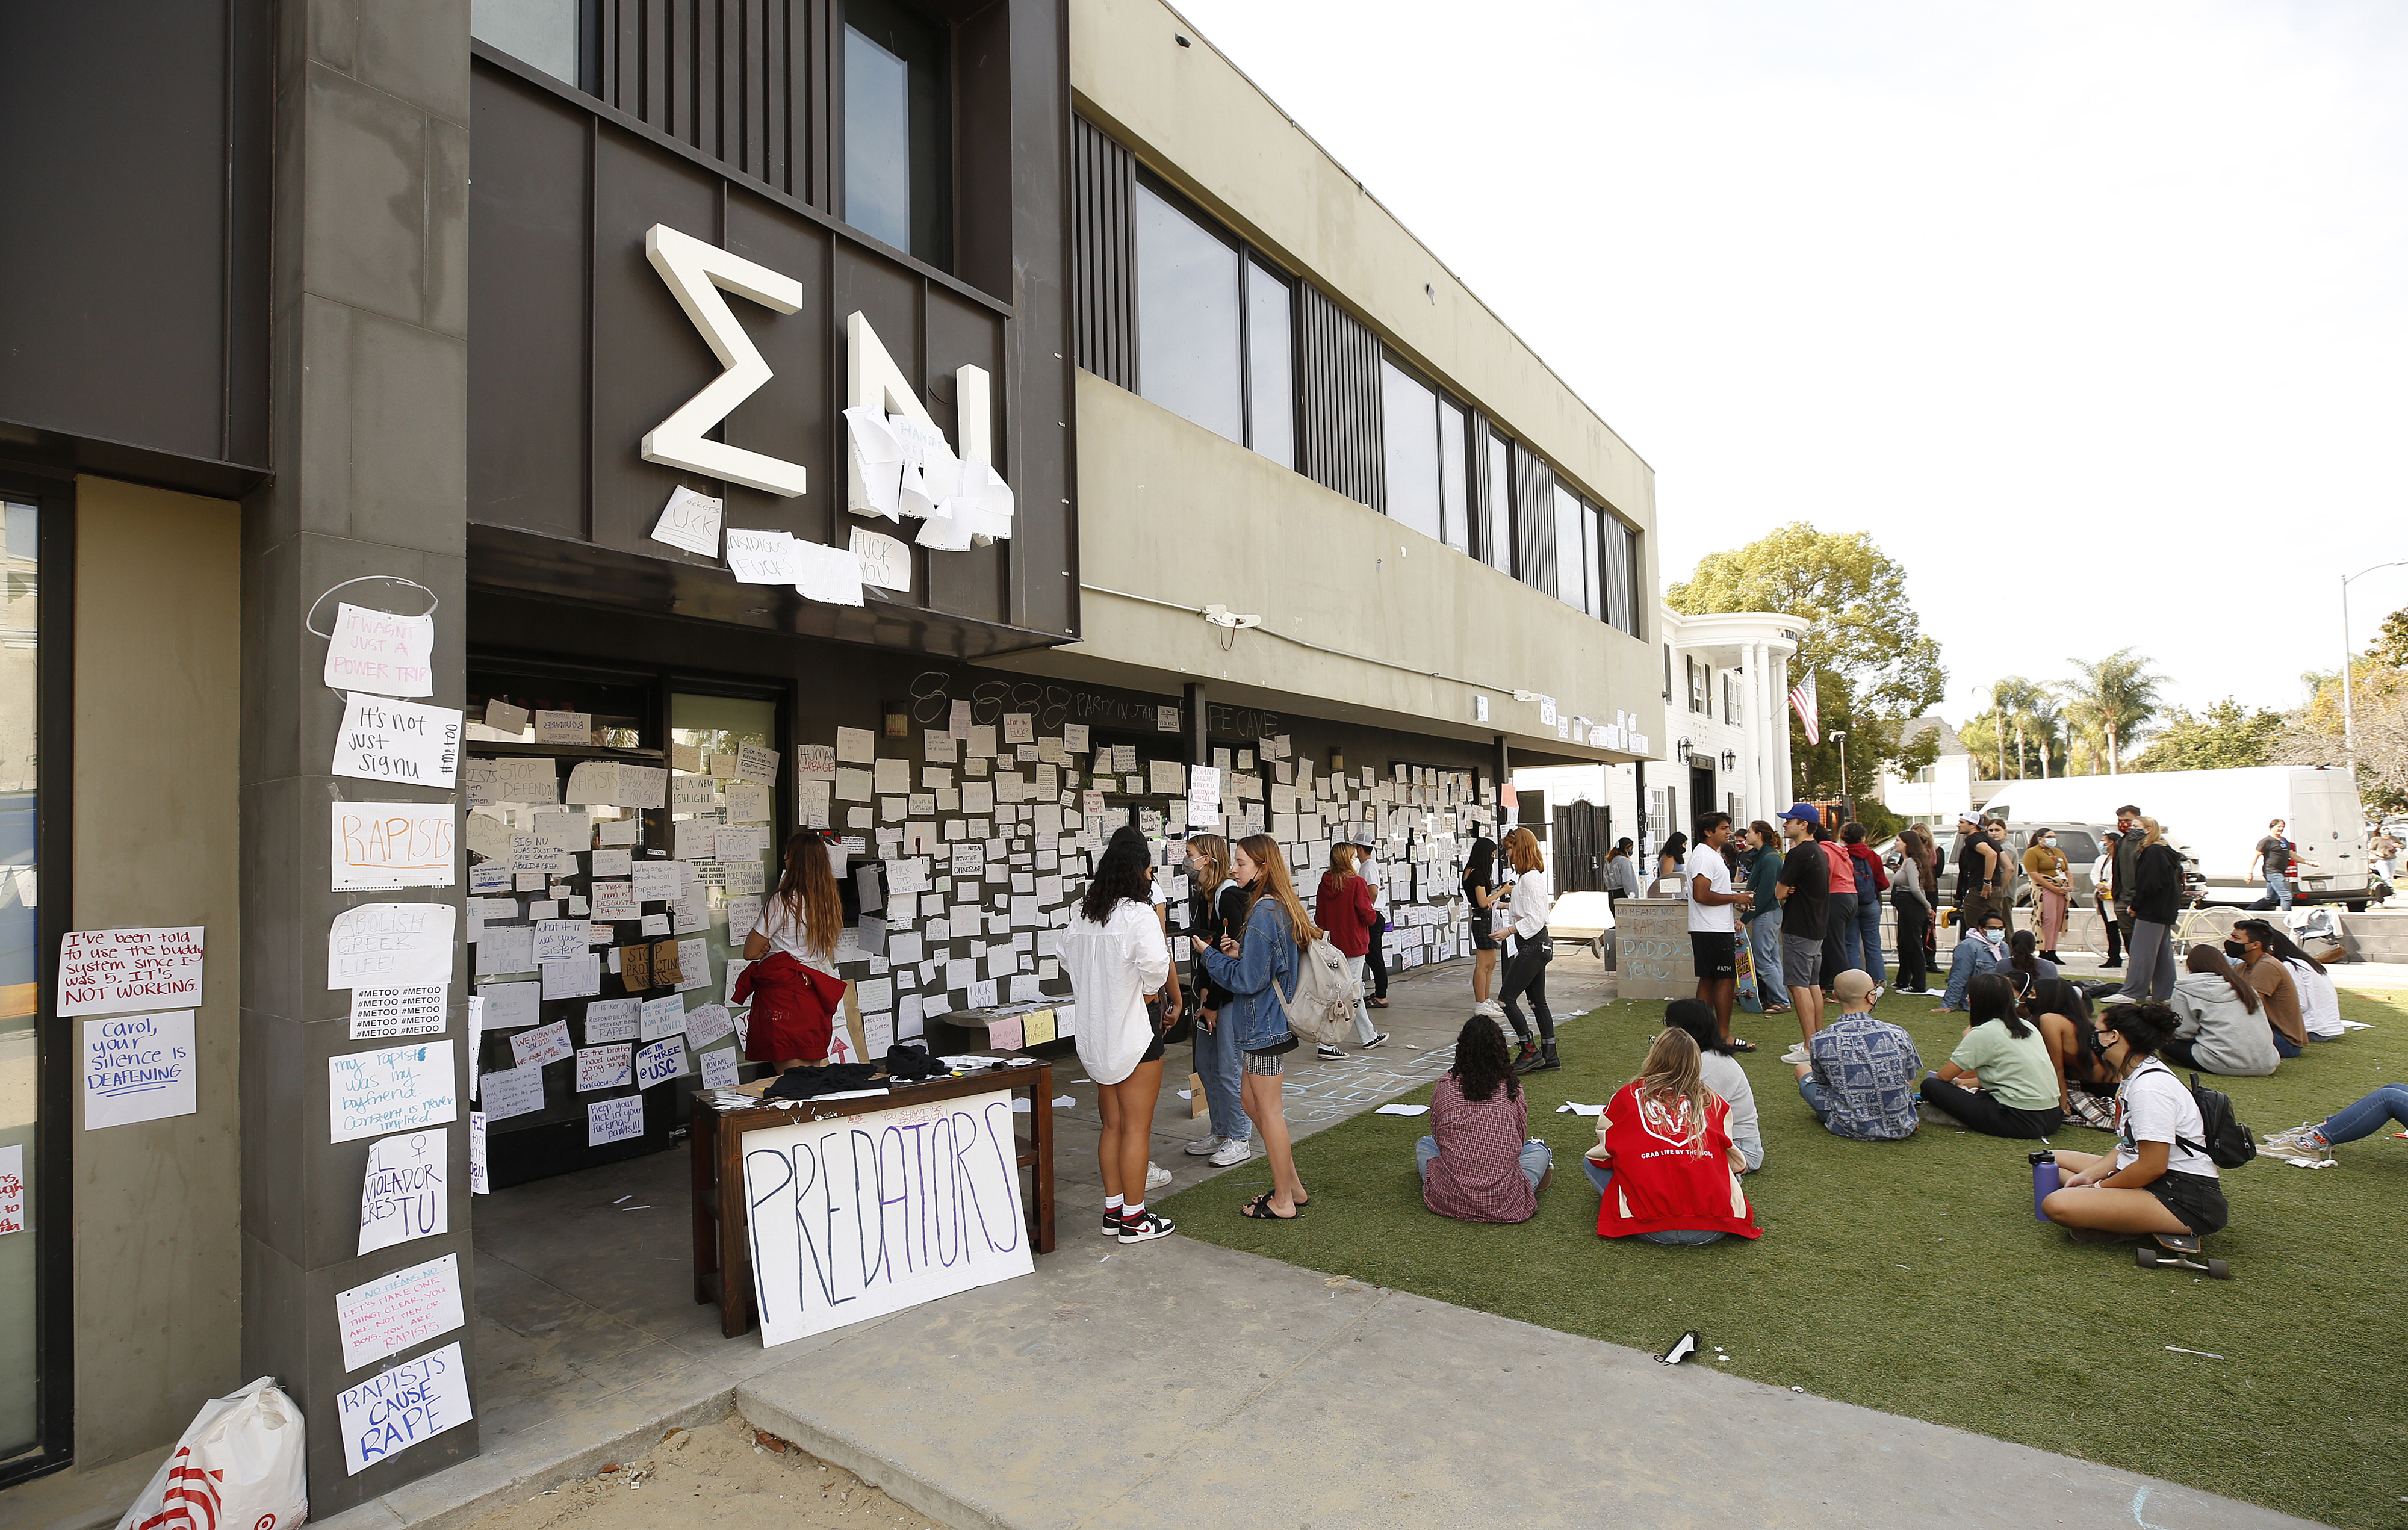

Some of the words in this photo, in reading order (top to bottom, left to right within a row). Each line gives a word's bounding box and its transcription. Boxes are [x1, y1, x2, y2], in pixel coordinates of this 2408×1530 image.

[687, 499, 721, 514] uckers
[672, 508, 715, 536] UCK
[853, 532, 893, 564] FUCK
[736, 557, 794, 577] FUCKS
[861, 563, 890, 584] YOU
[346, 615, 359, 630] IT
[351, 636, 386, 652] JUST
[394, 642, 408, 656] A
[395, 666, 428, 683] TRIP
[1075, 693, 1114, 717] PARTY
[1117, 704, 1127, 720] IN
[1130, 704, 1158, 721] JAIL
[361, 706, 386, 728] It's
[392, 714, 428, 736] not
[1237, 710, 1278, 737] CAVE
[348, 728, 389, 750] just
[800, 748, 834, 762] HUMAN
[500, 763, 536, 779] STOP
[798, 761, 834, 772] GARBAGE
[504, 782, 557, 798] DEFENDING
[570, 770, 618, 793] RAPISTS
[342, 814, 453, 862] RAPISTS
[513, 837, 532, 847] SIG
[512, 862, 539, 871] ABOLISH
[335, 914, 426, 937] ABOLISH
[562, 921, 571, 931] if
[1634, 919, 1681, 935] RAPISTS
[67, 933, 105, 947] I've
[114, 932, 151, 943] been
[158, 932, 190, 943] told
[336, 936, 417, 953] GREEK
[538, 935, 554, 944] was
[557, 935, 578, 947] your
[65, 948, 82, 960] to
[90, 947, 117, 959] use
[125, 944, 156, 956] the
[161, 944, 204, 962] buddy
[66, 959, 126, 977] system
[134, 957, 175, 969] since
[180, 956, 189, 967] I
[339, 956, 395, 974] LIFE!
[65, 976, 96, 987] was
[128, 968, 172, 982] IT'S
[65, 987, 109, 1005] NOT
[116, 979, 198, 997] WORKING.
[358, 988, 399, 997] #METOO
[403, 986, 441, 995] #METOO
[970, 982, 991, 997] FUCK
[357, 1008, 398, 1017] #METOO
[402, 1006, 440, 1014] #METOO
[358, 998, 399, 1007] #METOO
[975, 997, 990, 1007] YOU
[102, 1018, 157, 1037] Carol,
[356, 1018, 397, 1027] #METOO
[401, 1015, 439, 1024] #METOO
[356, 1028, 397, 1037] #METOO
[400, 1025, 439, 1034] #METOO
[93, 1036, 145, 1057] your
[639, 1047, 651, 1059] ONE
[654, 1043, 663, 1052] IN
[647, 1045, 681, 1063] THREE
[88, 1064, 183, 1089] DEAFENING
[335, 1059, 365, 1080] my
[346, 1075, 379, 1092] was
[391, 1067, 421, 1087] my
[409, 1105, 418, 1114] is
[423, 1096, 453, 1111] never
[615, 1099, 635, 1112] your
[612, 1110, 621, 1119] in
[624, 1107, 642, 1123] your
[880, 1112, 898, 1121] YOU
[591, 1119, 625, 1135] fucking
[368, 1146, 396, 1177] EL
[365, 1164, 442, 1202] VIOLADOR
[362, 1197, 396, 1227] ERES
[394, 1190, 435, 1236] TU
[745, 1103, 1017, 1324] PREDATORS
[365, 1287, 380, 1299] NO
[385, 1274, 420, 1290] MEANS
[423, 1268, 438, 1278] NO
[379, 1288, 412, 1305] MAKE
[414, 1277, 441, 1293] ONE
[424, 1287, 446, 1298] YOU
[349, 1325, 370, 1338] ARE
[376, 1315, 397, 1327] NOT
[400, 1306, 423, 1319] MEN
[426, 1301, 440, 1310] OR
[383, 1325, 404, 1336] YOU
[411, 1313, 434, 1325] ARE
[383, 1322, 440, 1350] RAPISTS
[343, 1351, 445, 1413] RAPISTS
[368, 1378, 435, 1426] CAUSE
[360, 1395, 444, 1461] RAPE
